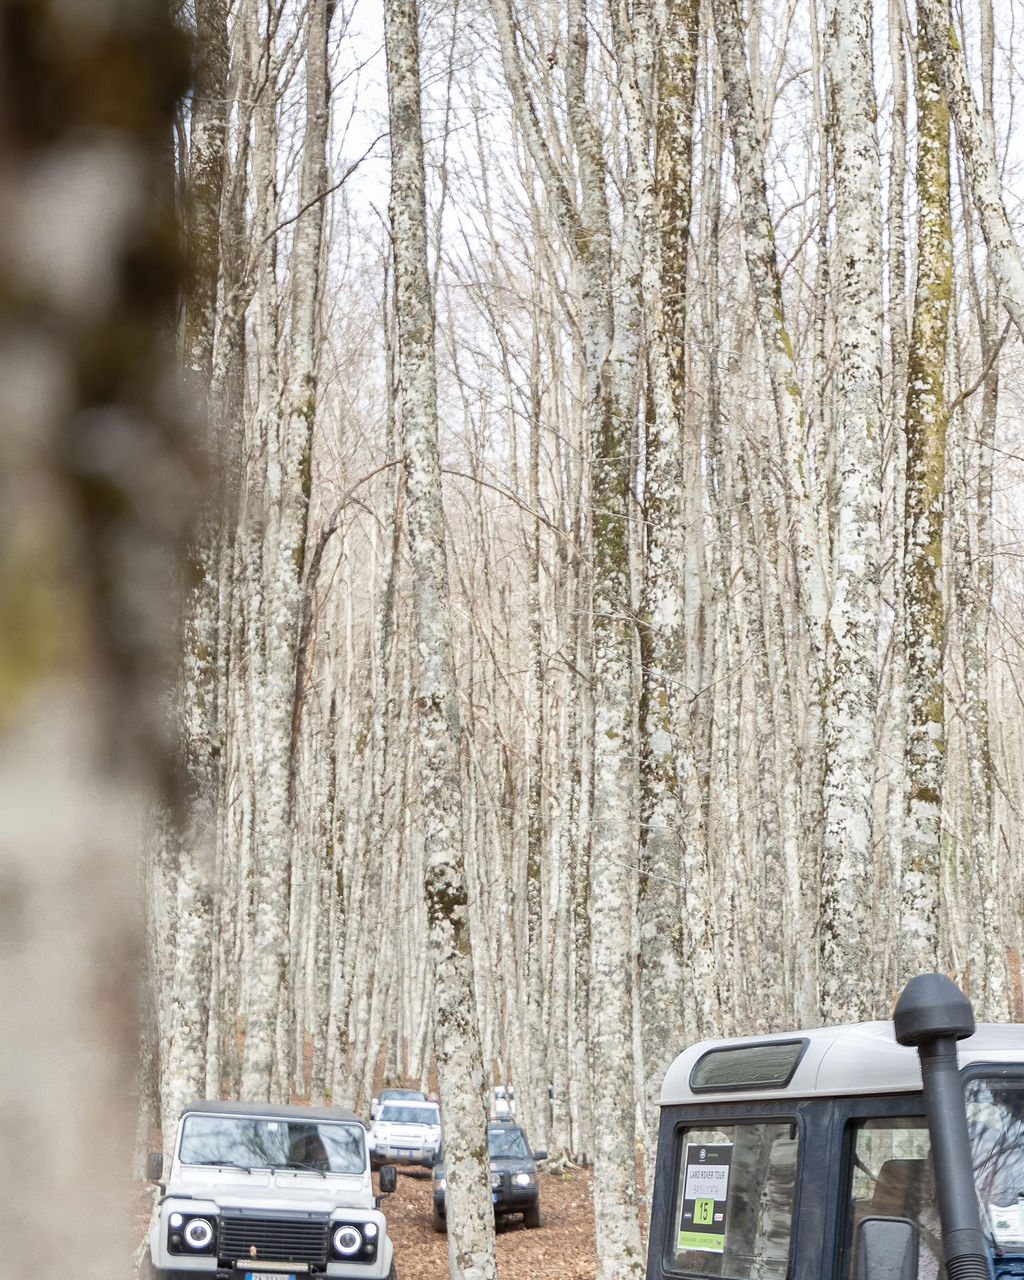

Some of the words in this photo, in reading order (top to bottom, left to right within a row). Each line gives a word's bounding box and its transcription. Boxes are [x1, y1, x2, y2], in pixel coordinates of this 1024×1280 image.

[701, 1170, 714, 1180] ROVER
[715, 1170, 725, 1180] TOUR
[699, 1202, 709, 1221] 15
